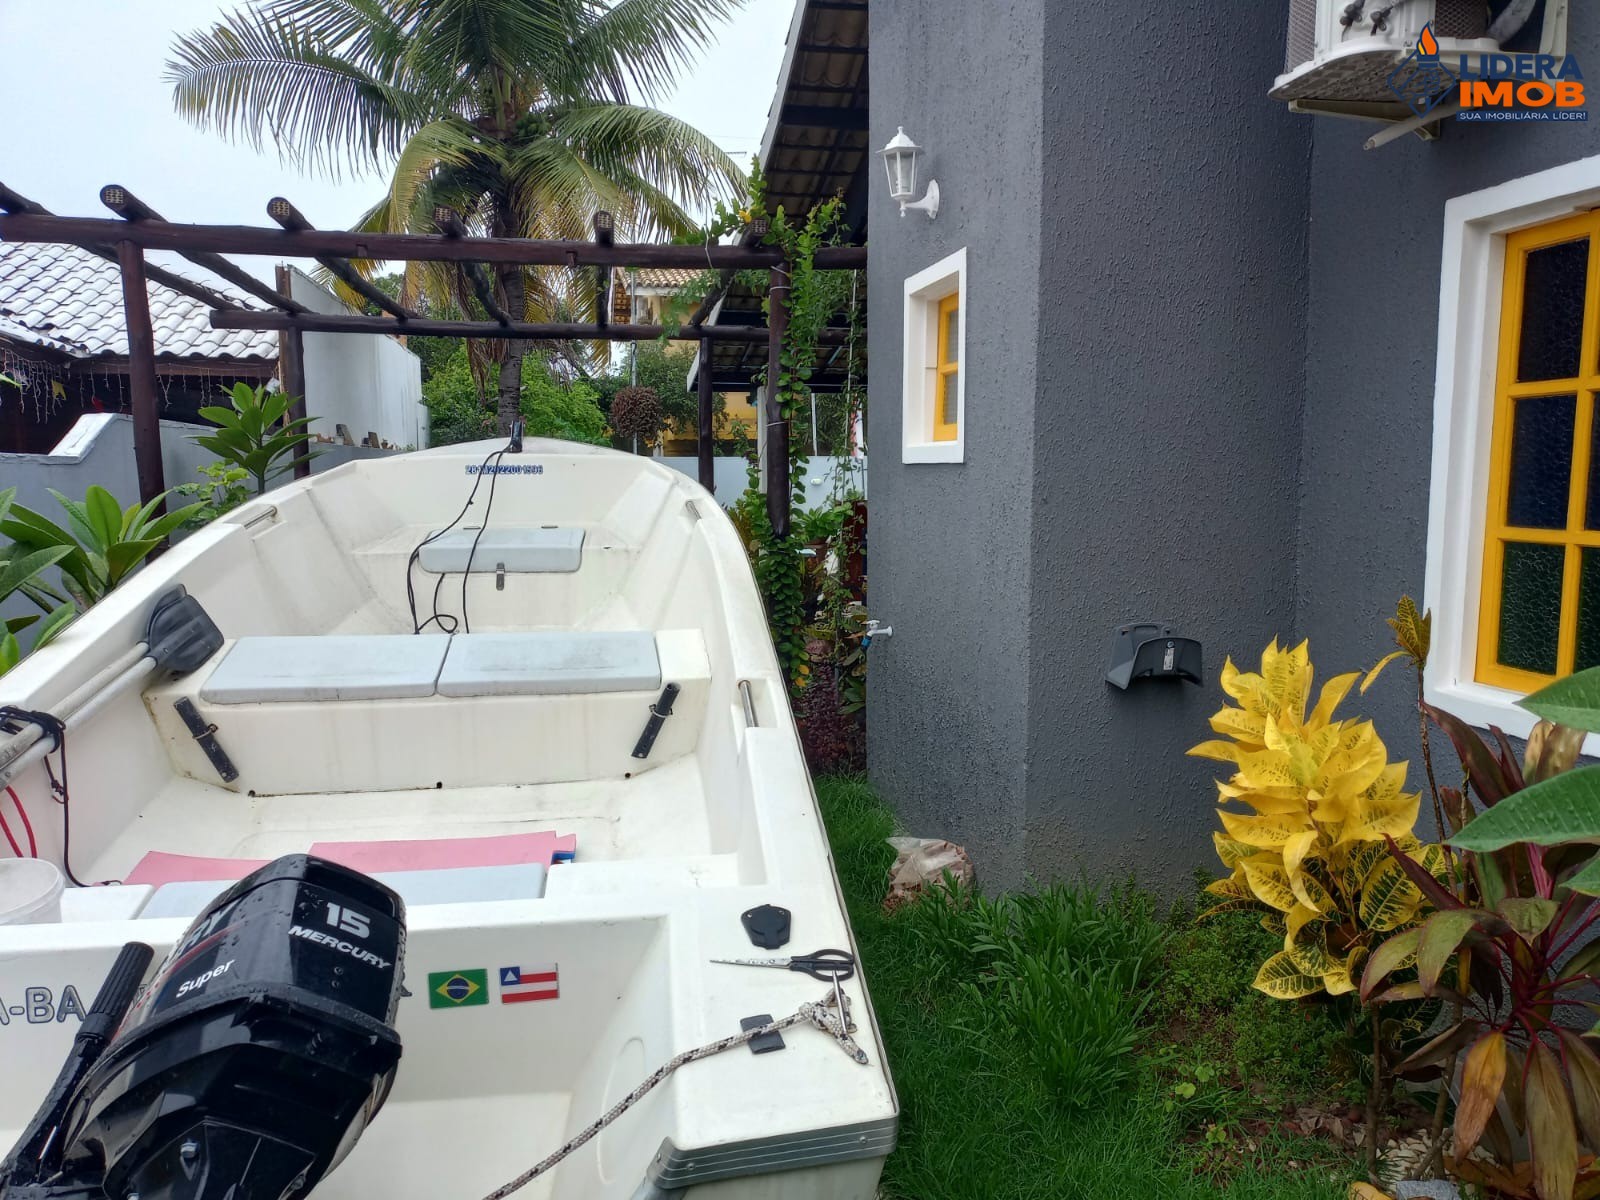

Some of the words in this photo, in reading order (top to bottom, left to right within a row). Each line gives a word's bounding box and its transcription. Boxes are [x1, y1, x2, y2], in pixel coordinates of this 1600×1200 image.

[326, 902, 371, 939] 15
[287, 925, 392, 969] MERCURY
[175, 959, 236, 998] Super
